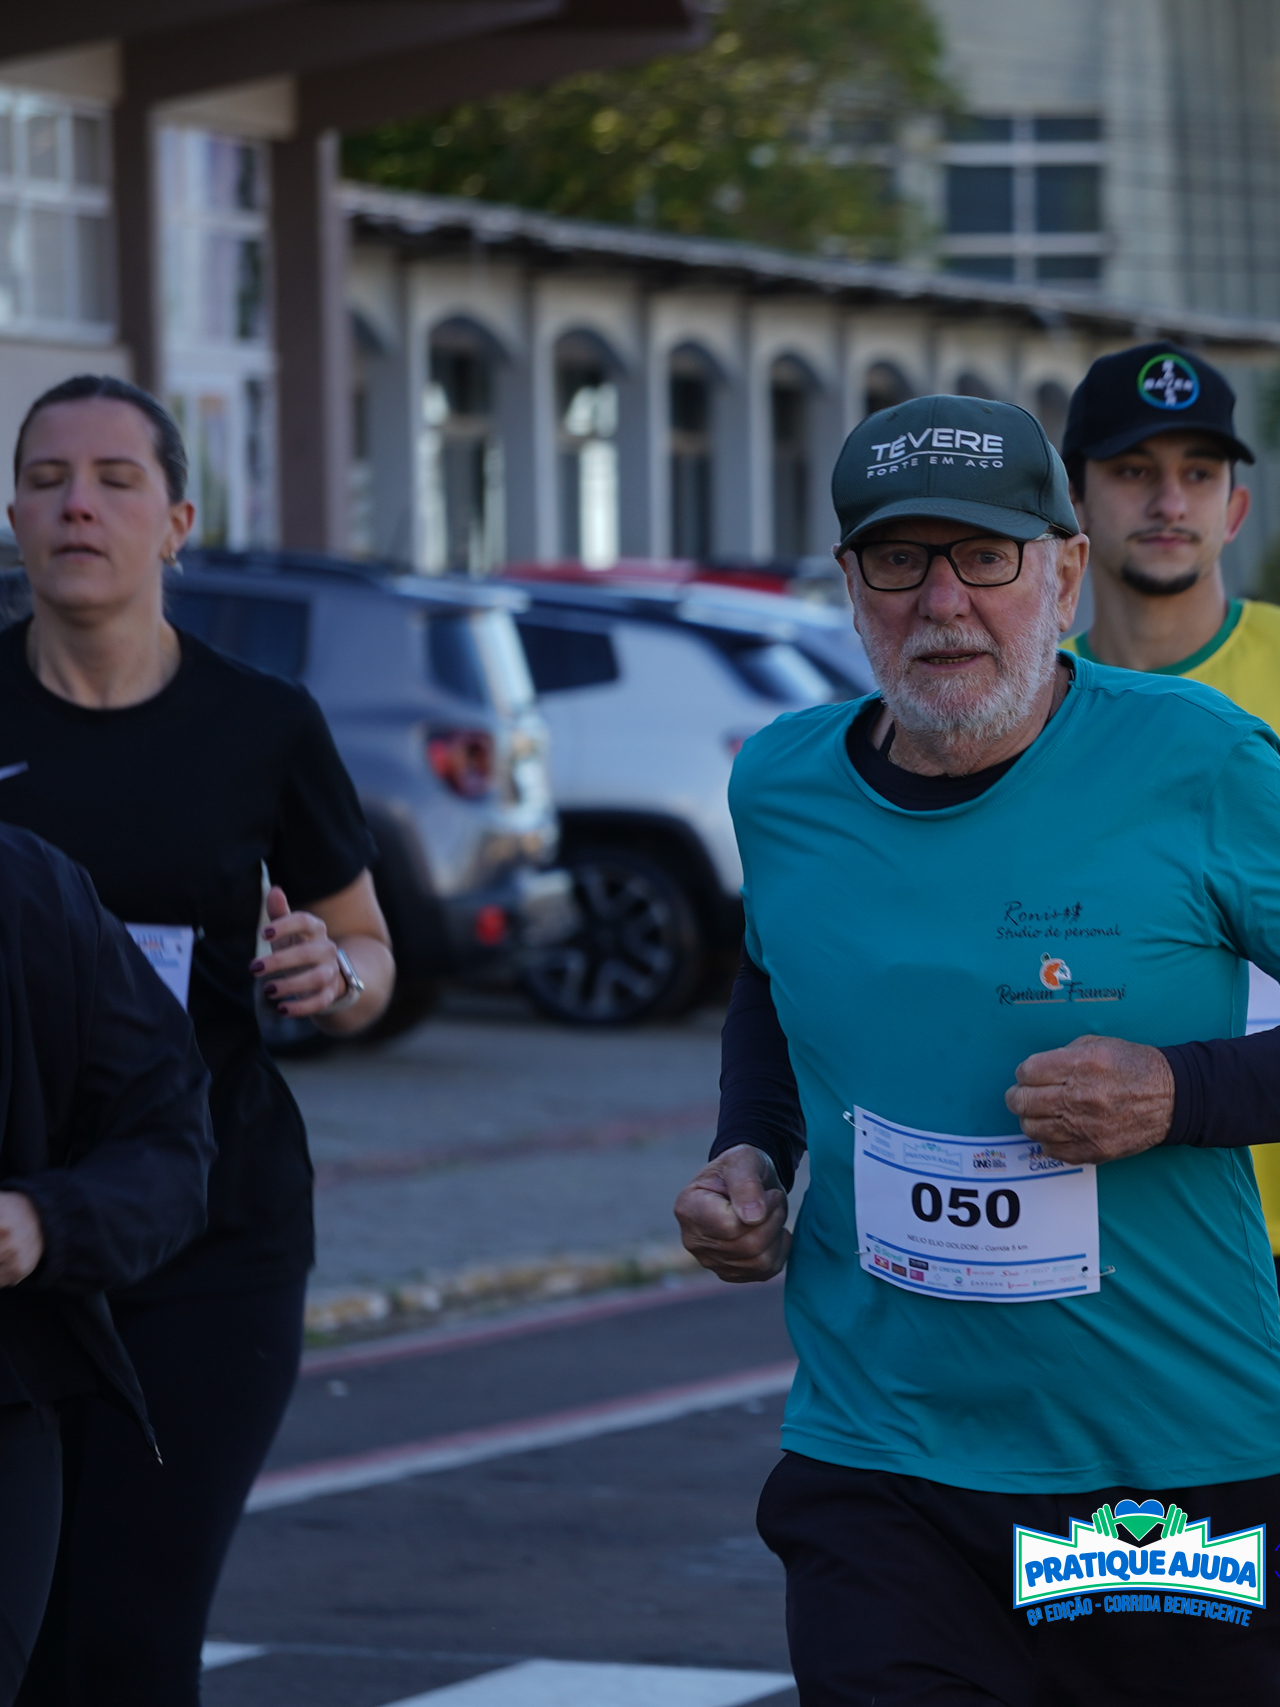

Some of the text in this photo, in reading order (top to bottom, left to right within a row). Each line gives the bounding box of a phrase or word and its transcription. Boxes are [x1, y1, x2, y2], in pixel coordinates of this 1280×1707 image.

[871, 428, 1003, 461] TEVERE
[867, 456, 1003, 478] FORTE EM AÇO
[996, 924, 1122, 941] Studio de personal
[911, 1182, 1020, 1228] 050
